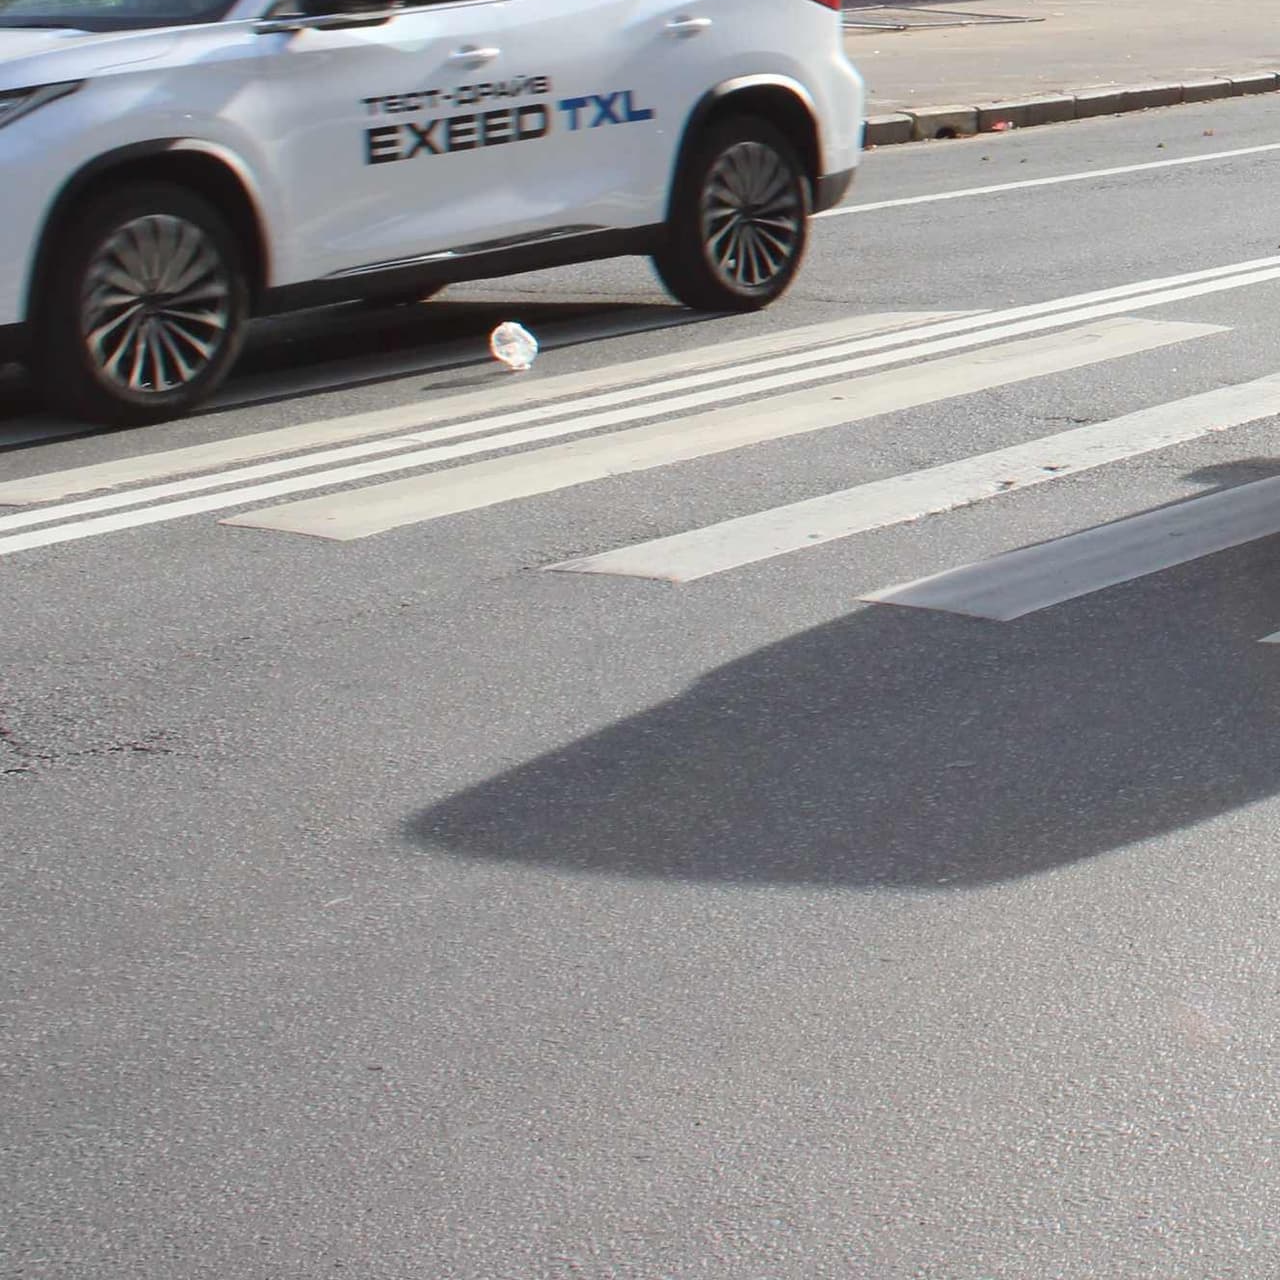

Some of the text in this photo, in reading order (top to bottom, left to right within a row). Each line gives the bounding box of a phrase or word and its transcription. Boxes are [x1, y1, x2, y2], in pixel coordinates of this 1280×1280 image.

[361, 75, 553, 116] ТЕСТ-ДРАЙВ
[365, 90, 655, 165] EXEED TXL
